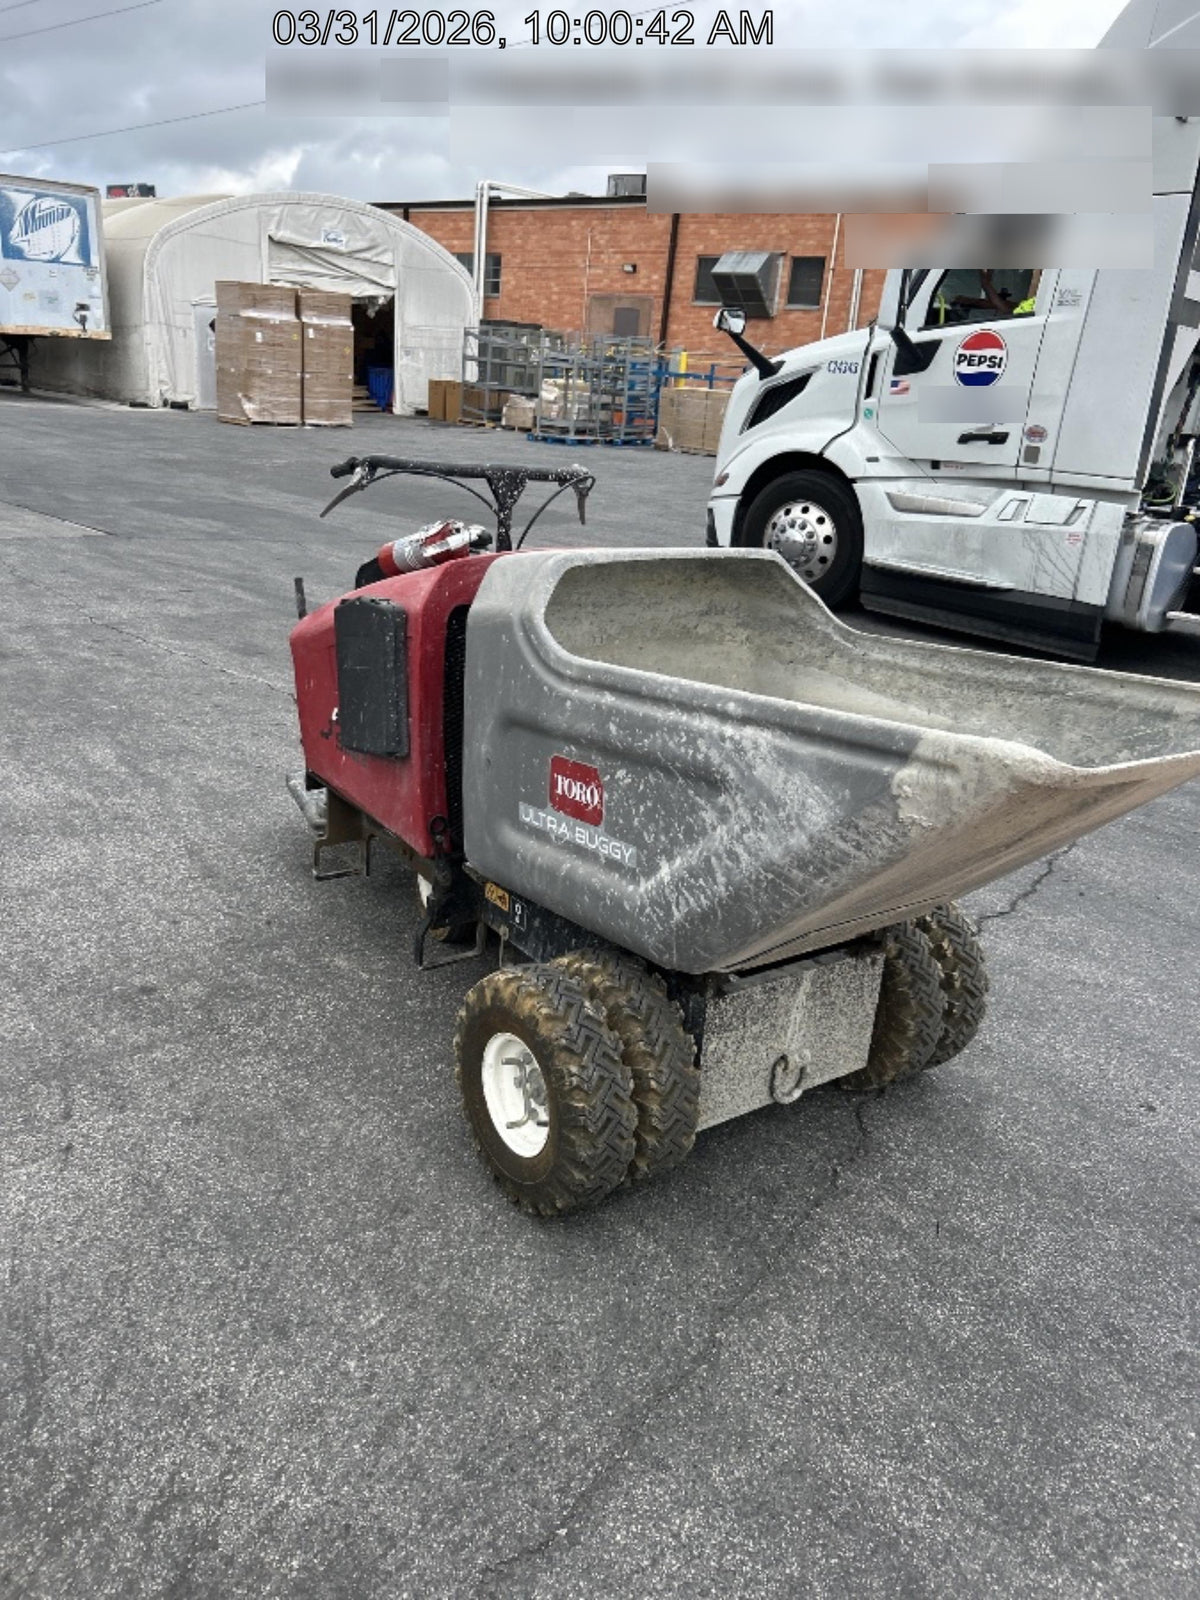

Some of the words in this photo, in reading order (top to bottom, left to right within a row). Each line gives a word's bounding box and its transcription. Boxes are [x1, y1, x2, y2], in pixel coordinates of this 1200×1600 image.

[957, 353, 1003, 369] PEPSI
[553, 773, 600, 809] TORO
[521, 809, 570, 840] ULTRA
[575, 827, 633, 863] BUGGY
